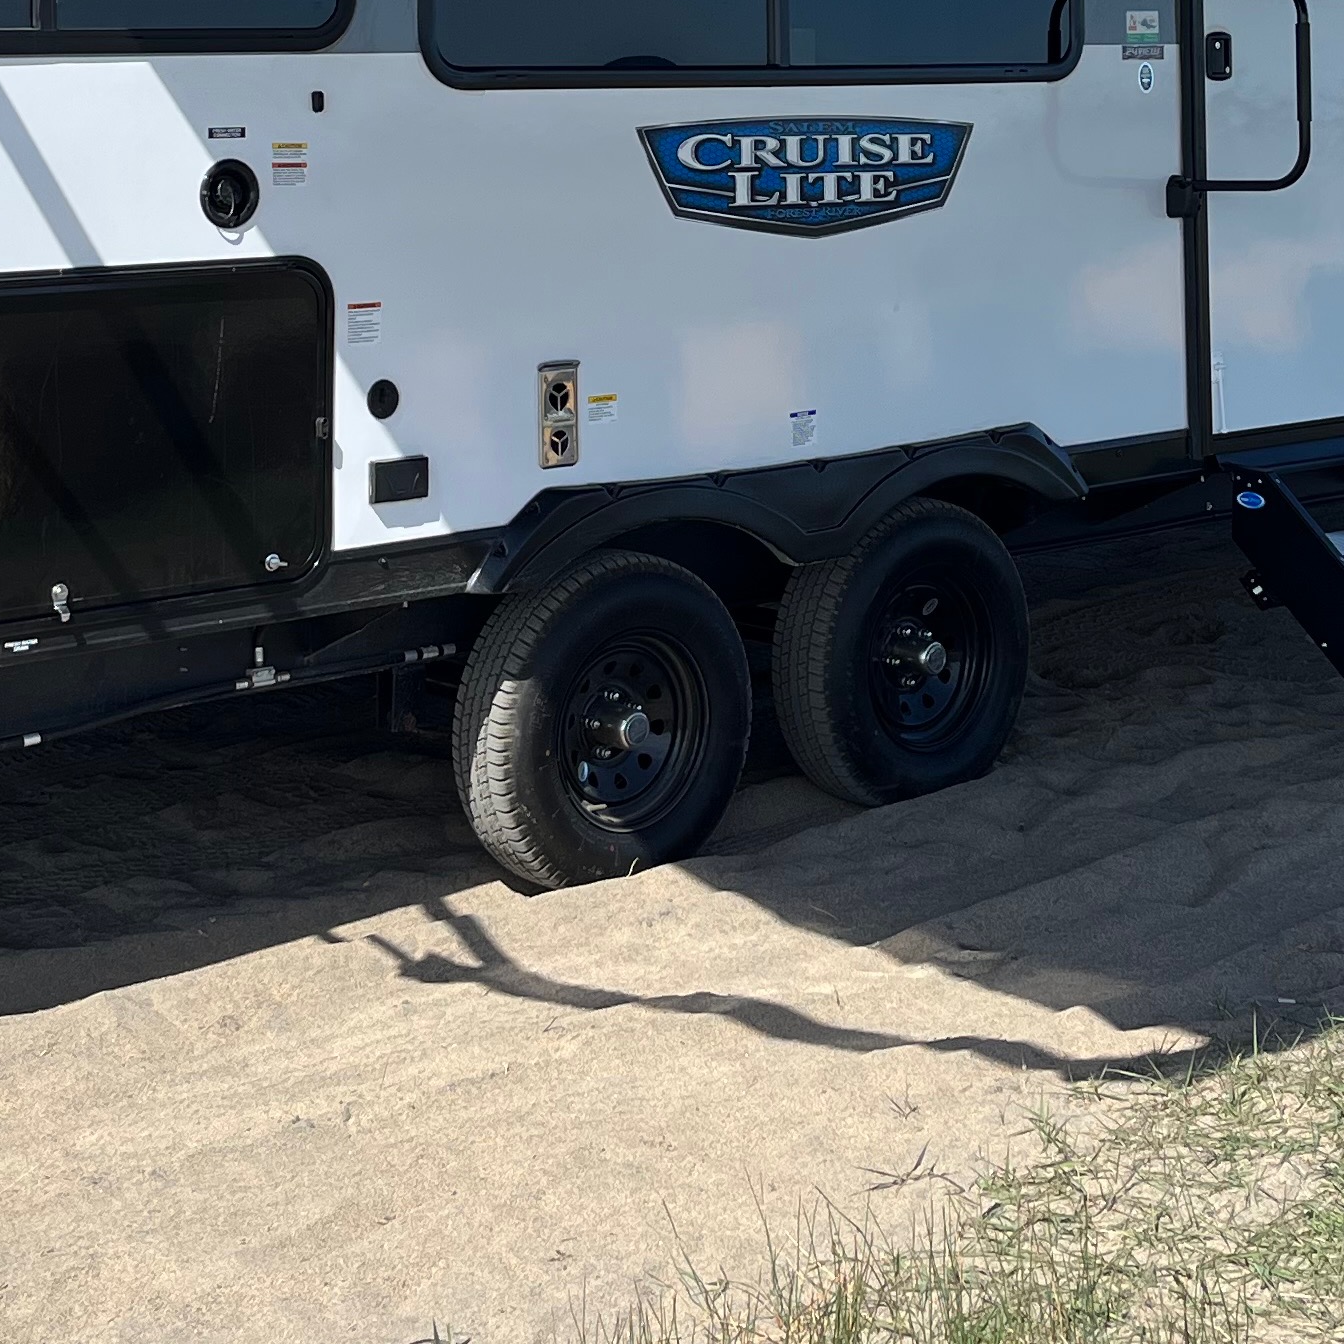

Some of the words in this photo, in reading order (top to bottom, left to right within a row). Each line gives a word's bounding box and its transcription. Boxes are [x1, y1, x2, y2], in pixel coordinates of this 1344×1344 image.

[768, 120, 856, 133] SALEM
[677, 133, 934, 170] CRUISE
[728, 171, 898, 207] LITE
[766, 207, 818, 219] FOREST
[823, 206, 862, 217] RIVER
